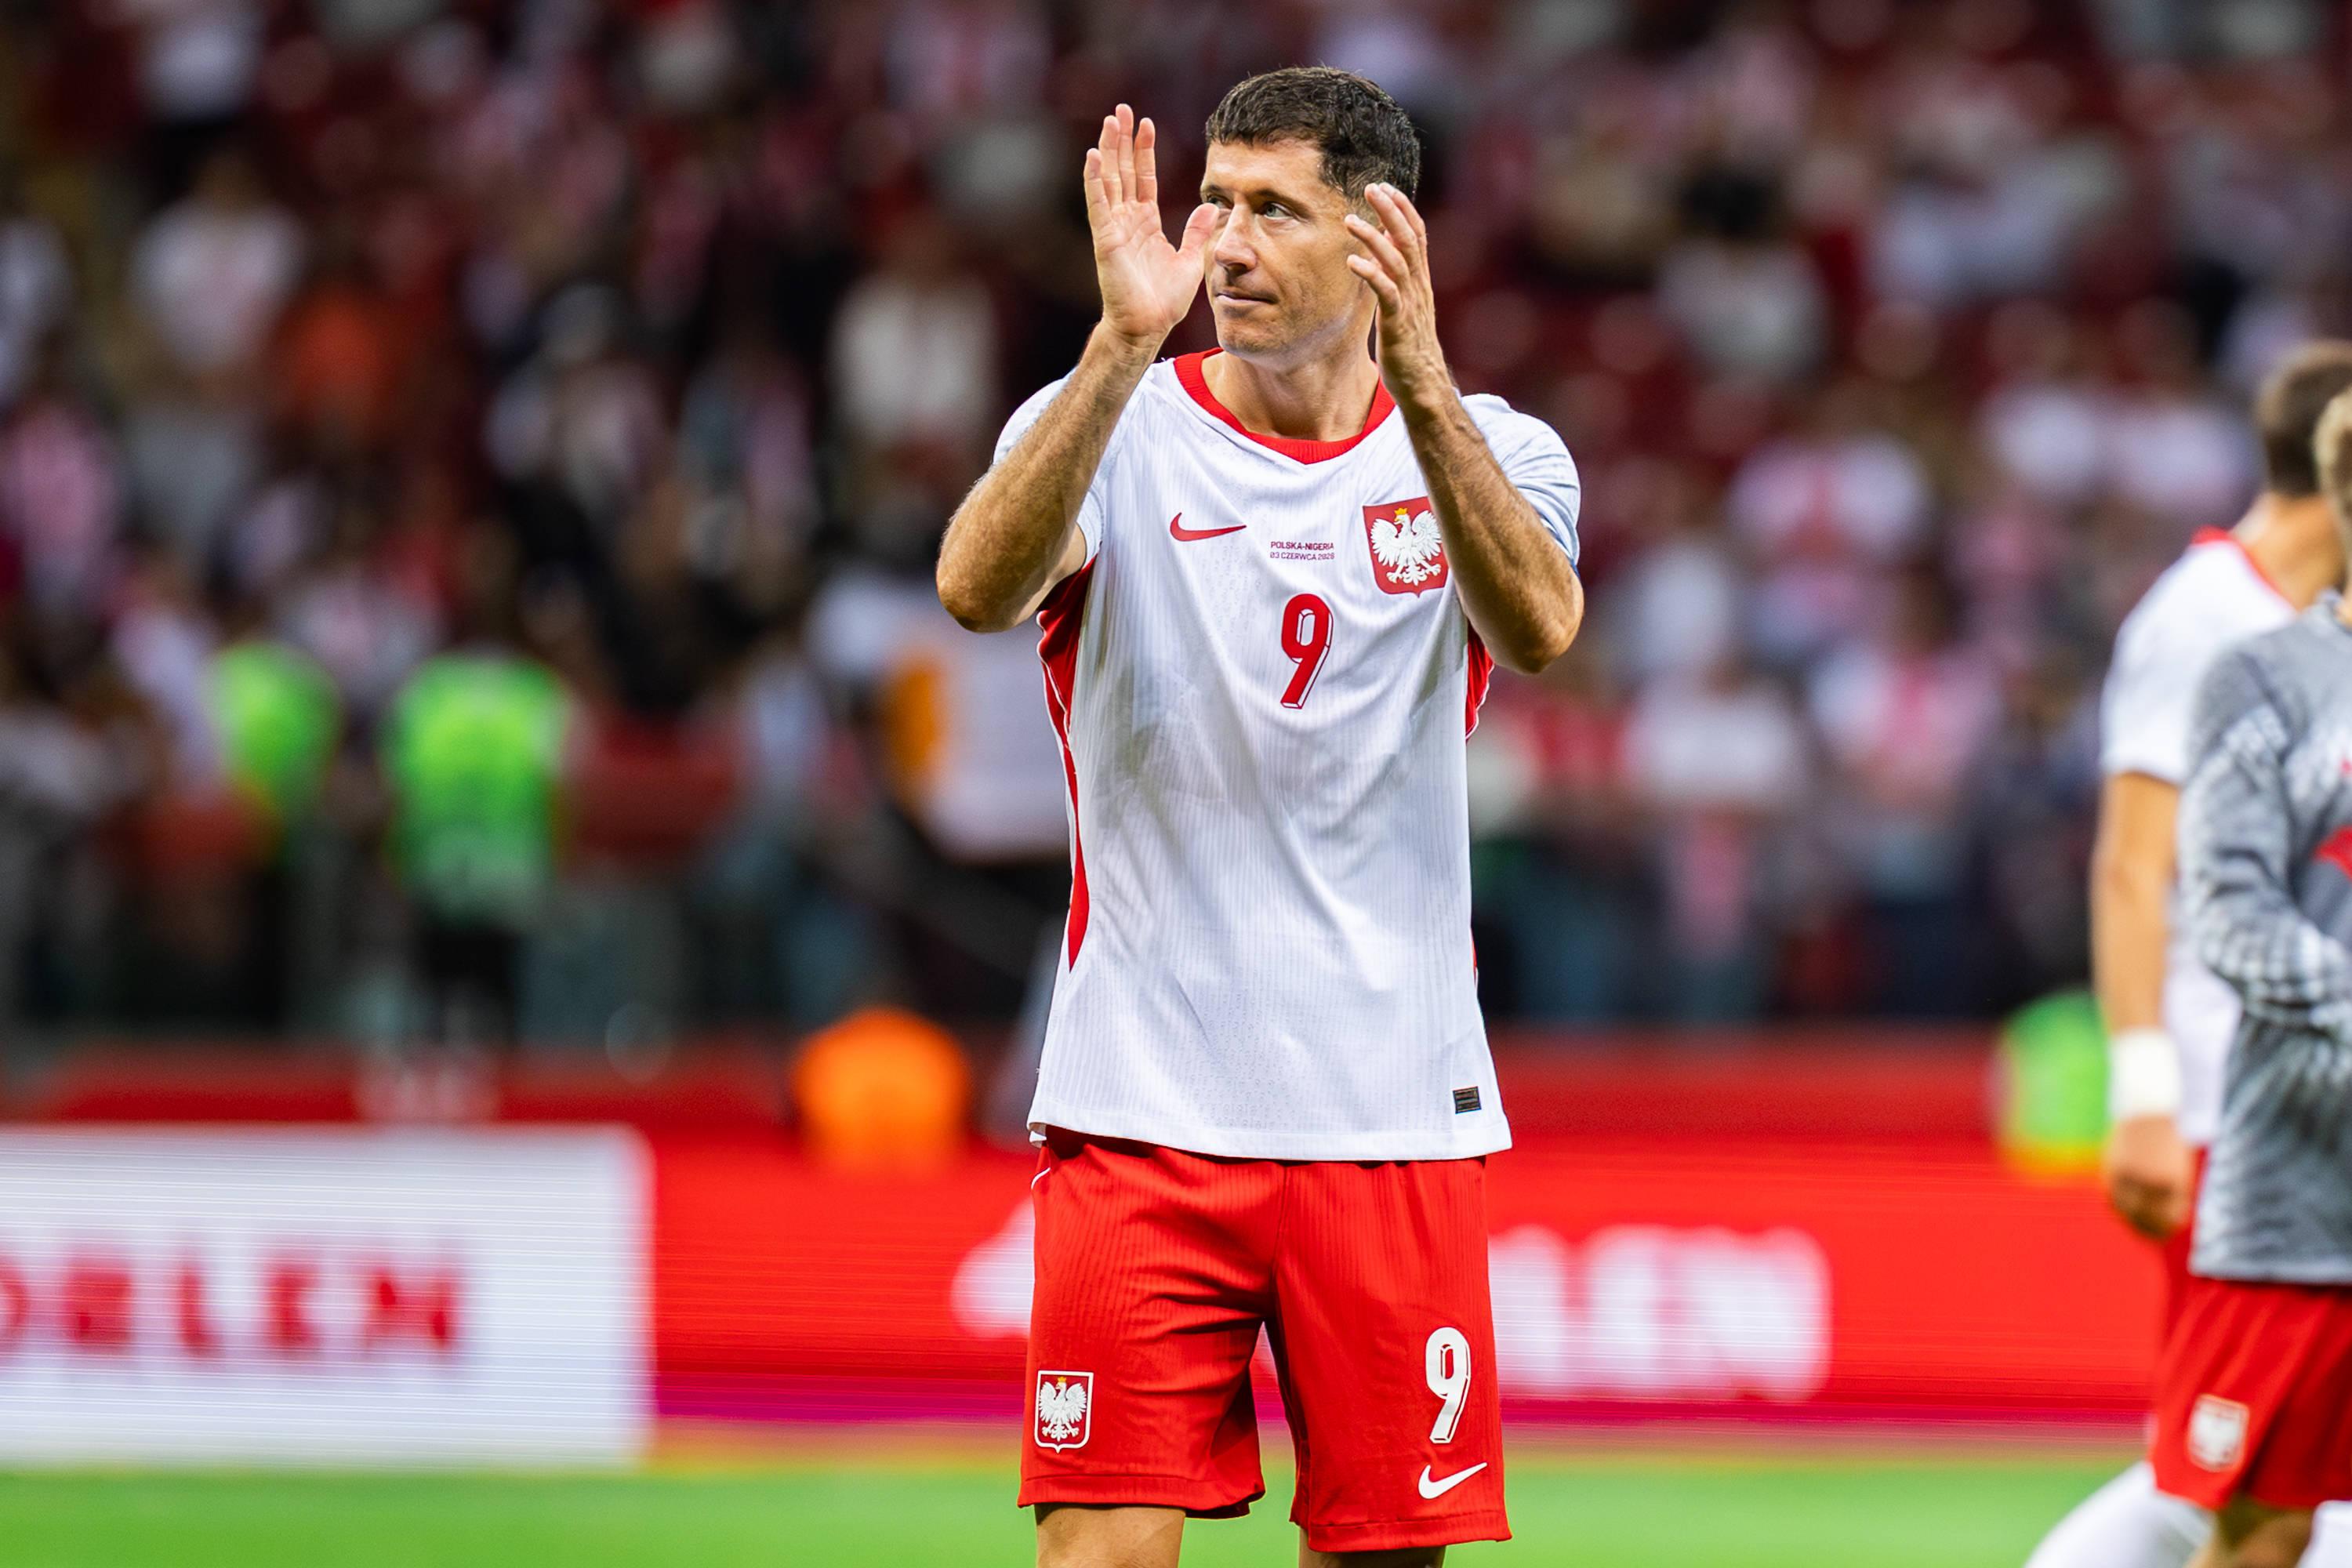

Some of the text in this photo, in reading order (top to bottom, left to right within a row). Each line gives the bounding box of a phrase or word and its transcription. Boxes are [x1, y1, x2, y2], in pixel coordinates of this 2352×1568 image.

[1270, 541, 1334, 550] POLSKA-NIGERIA
[1281, 552, 1316, 561] CZERWCA
[1280, 593, 1334, 710] 9
[1425, 1327, 1471, 1444] 9
